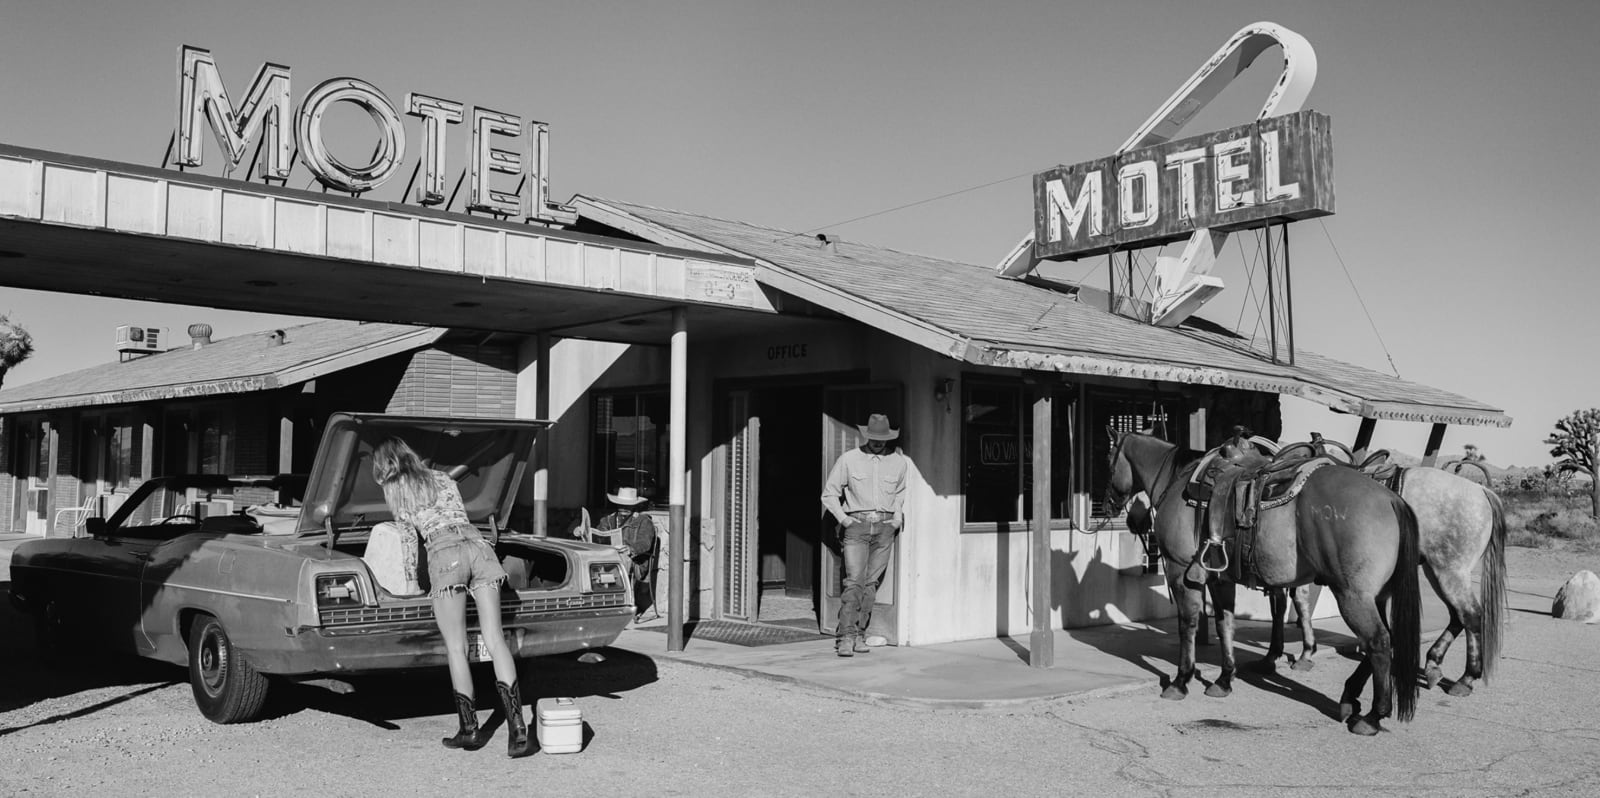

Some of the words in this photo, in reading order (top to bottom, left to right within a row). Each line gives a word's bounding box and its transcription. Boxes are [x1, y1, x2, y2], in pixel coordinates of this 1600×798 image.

[172, 44, 579, 225] MOTEL
[1046, 130, 1300, 243] MOTEL
[767, 343, 808, 361] OFFICE
[984, 440, 1001, 461] NO
